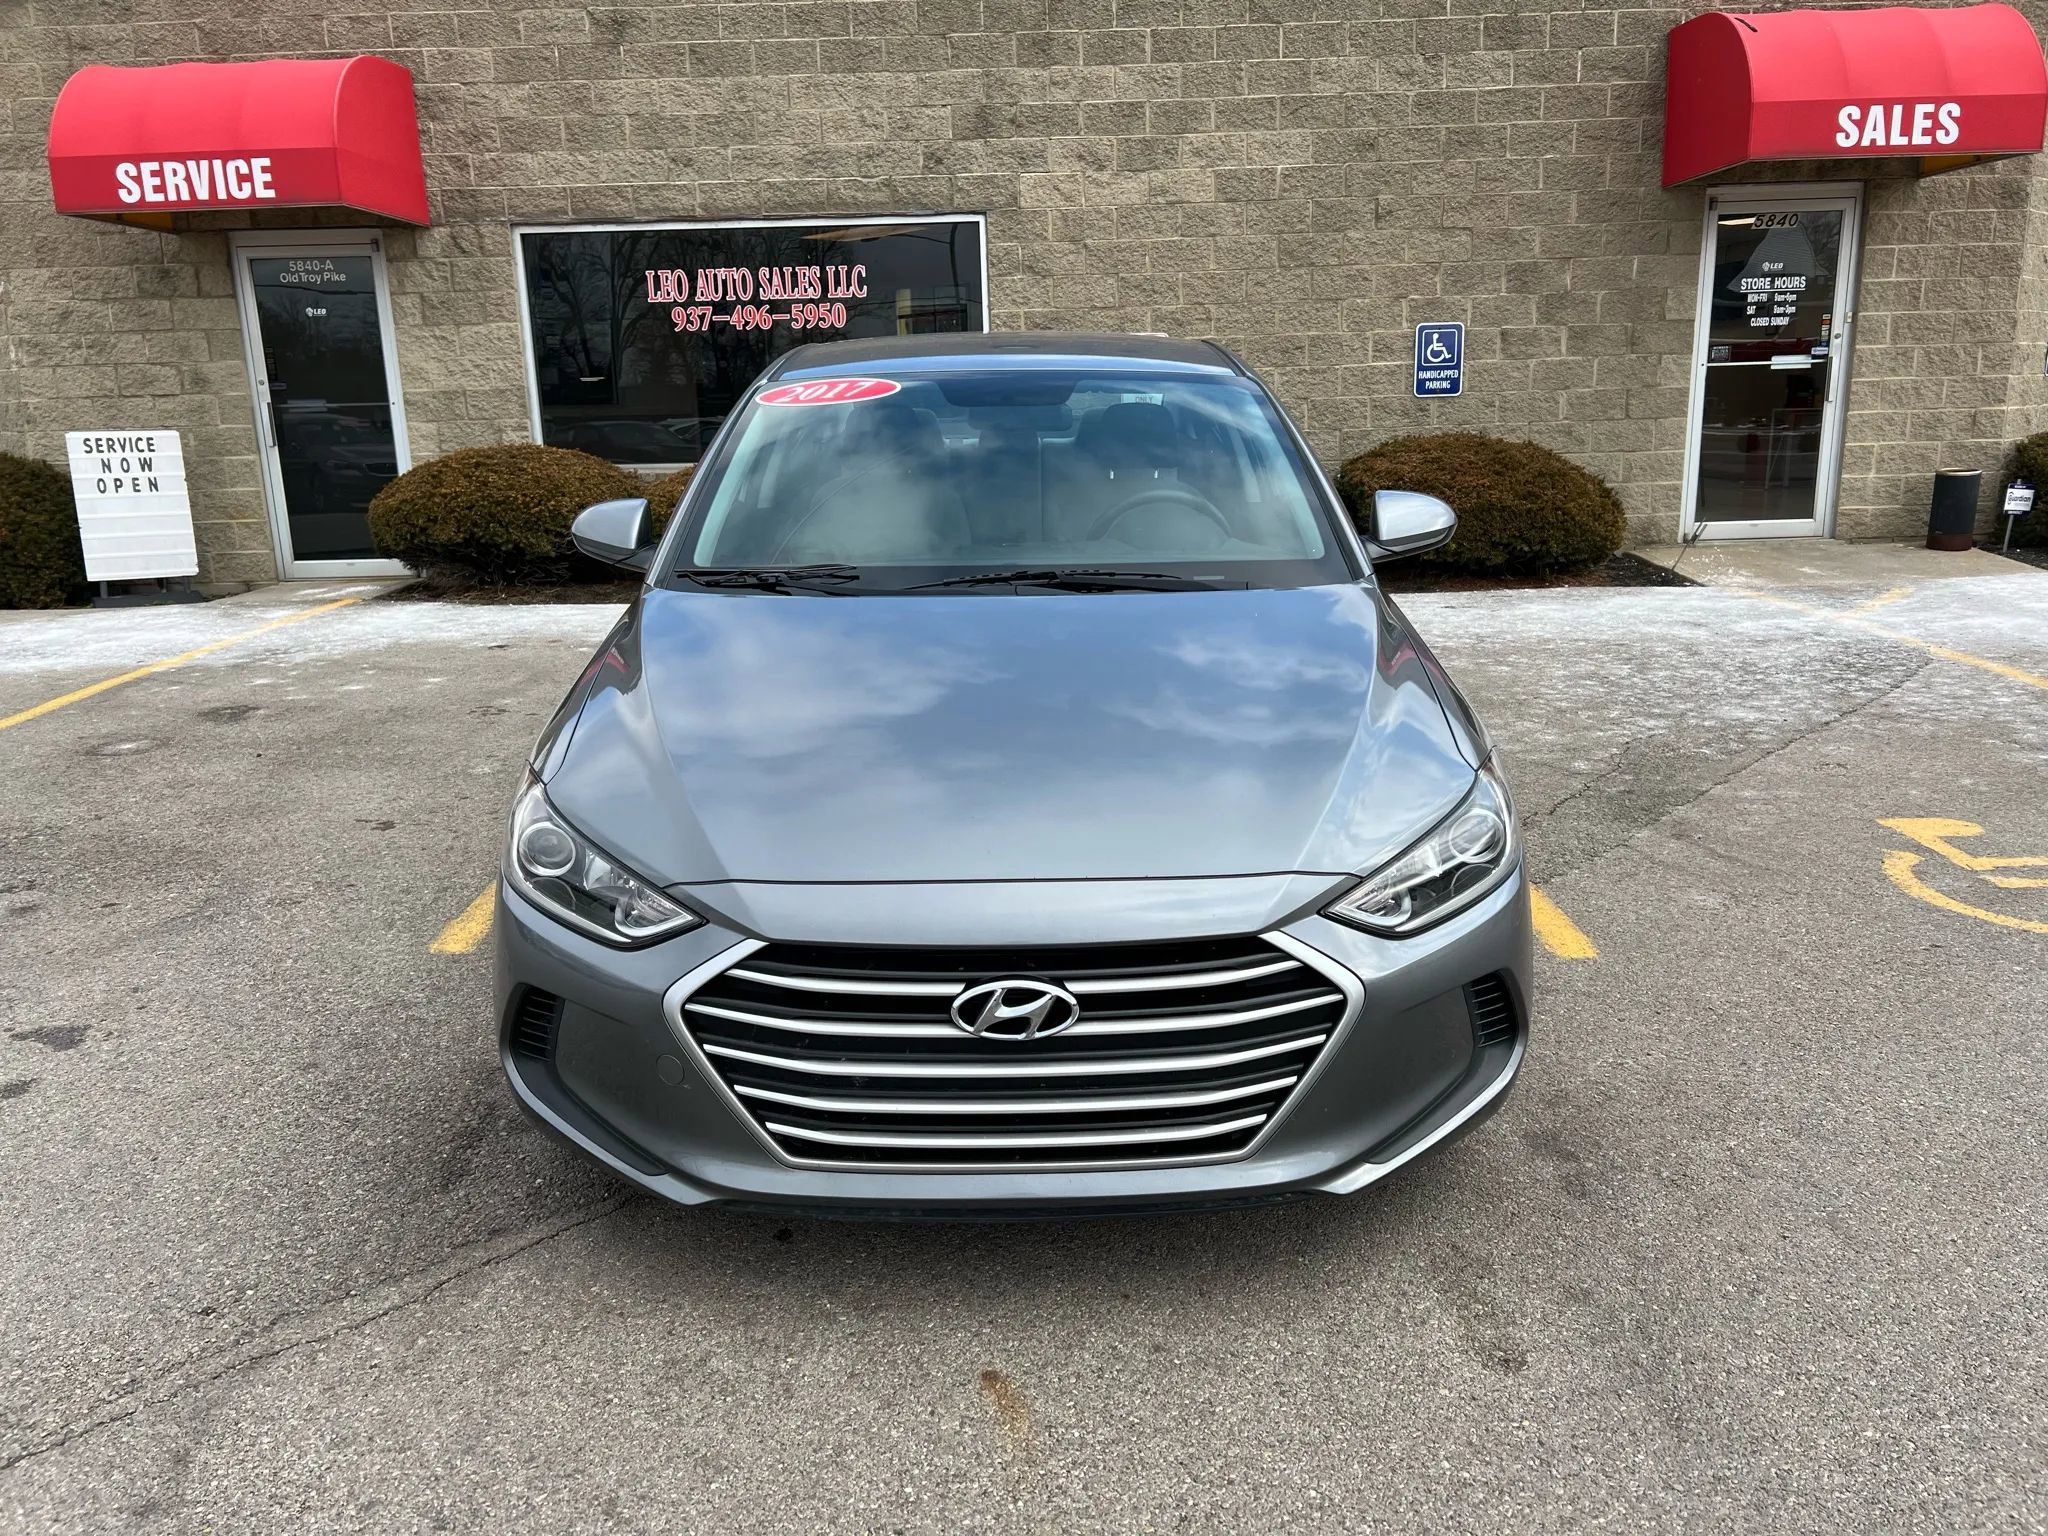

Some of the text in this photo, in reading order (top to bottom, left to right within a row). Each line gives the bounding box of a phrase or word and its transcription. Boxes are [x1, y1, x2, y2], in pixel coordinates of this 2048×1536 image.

[1835, 102, 1961, 148] SALES
[115, 157, 276, 204] SERVICE
[1754, 213, 1799, 228] 5840
[289, 260, 334, 271] 5840-A
[280, 271, 346, 284] Old Troy Pike
[645, 264, 868, 302] LEO AUTO SALES LLC
[1740, 276, 1807, 290] STORE HOURS
[1747, 293, 1768, 303] MON-FRI
[671, 302, 847, 332] 937-496-5950
[1746, 305, 1757, 315] SAT
[1750, 316, 1790, 327] CLOSED SUNDAY
[1418, 369, 1459, 379] HANDICAPPED
[773, 380, 878, 403] 2017
[1425, 380, 1451, 390] PARKING
[82, 437, 156, 454] SERVICE
[100, 457, 153, 474] NOW
[96, 476, 160, 494] OPEN
